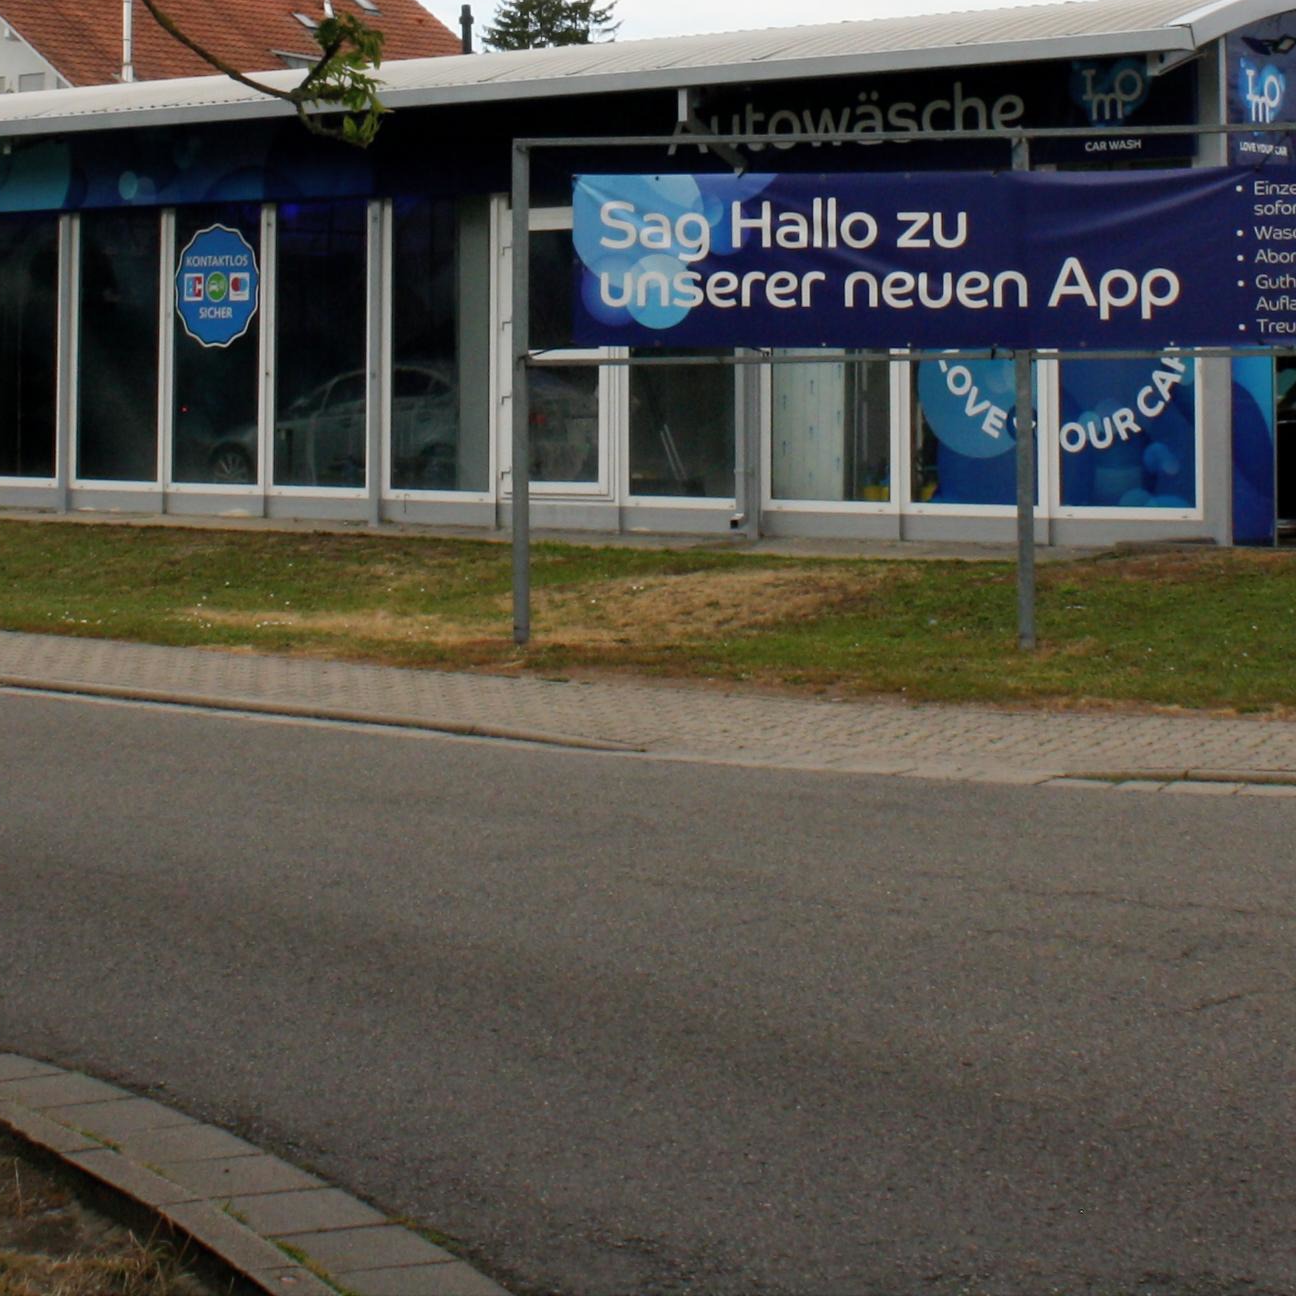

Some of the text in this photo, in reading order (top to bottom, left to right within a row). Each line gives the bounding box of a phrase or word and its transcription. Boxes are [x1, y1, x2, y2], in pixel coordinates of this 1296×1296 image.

[1085, 139, 1142, 151] CAR WASH
[600, 197, 968, 262] Sag Hallo zu
[186, 255, 248, 266] KONTAKTLOS
[600, 257, 1180, 320] unserer neuen App
[199, 307, 233, 319] SICHER
